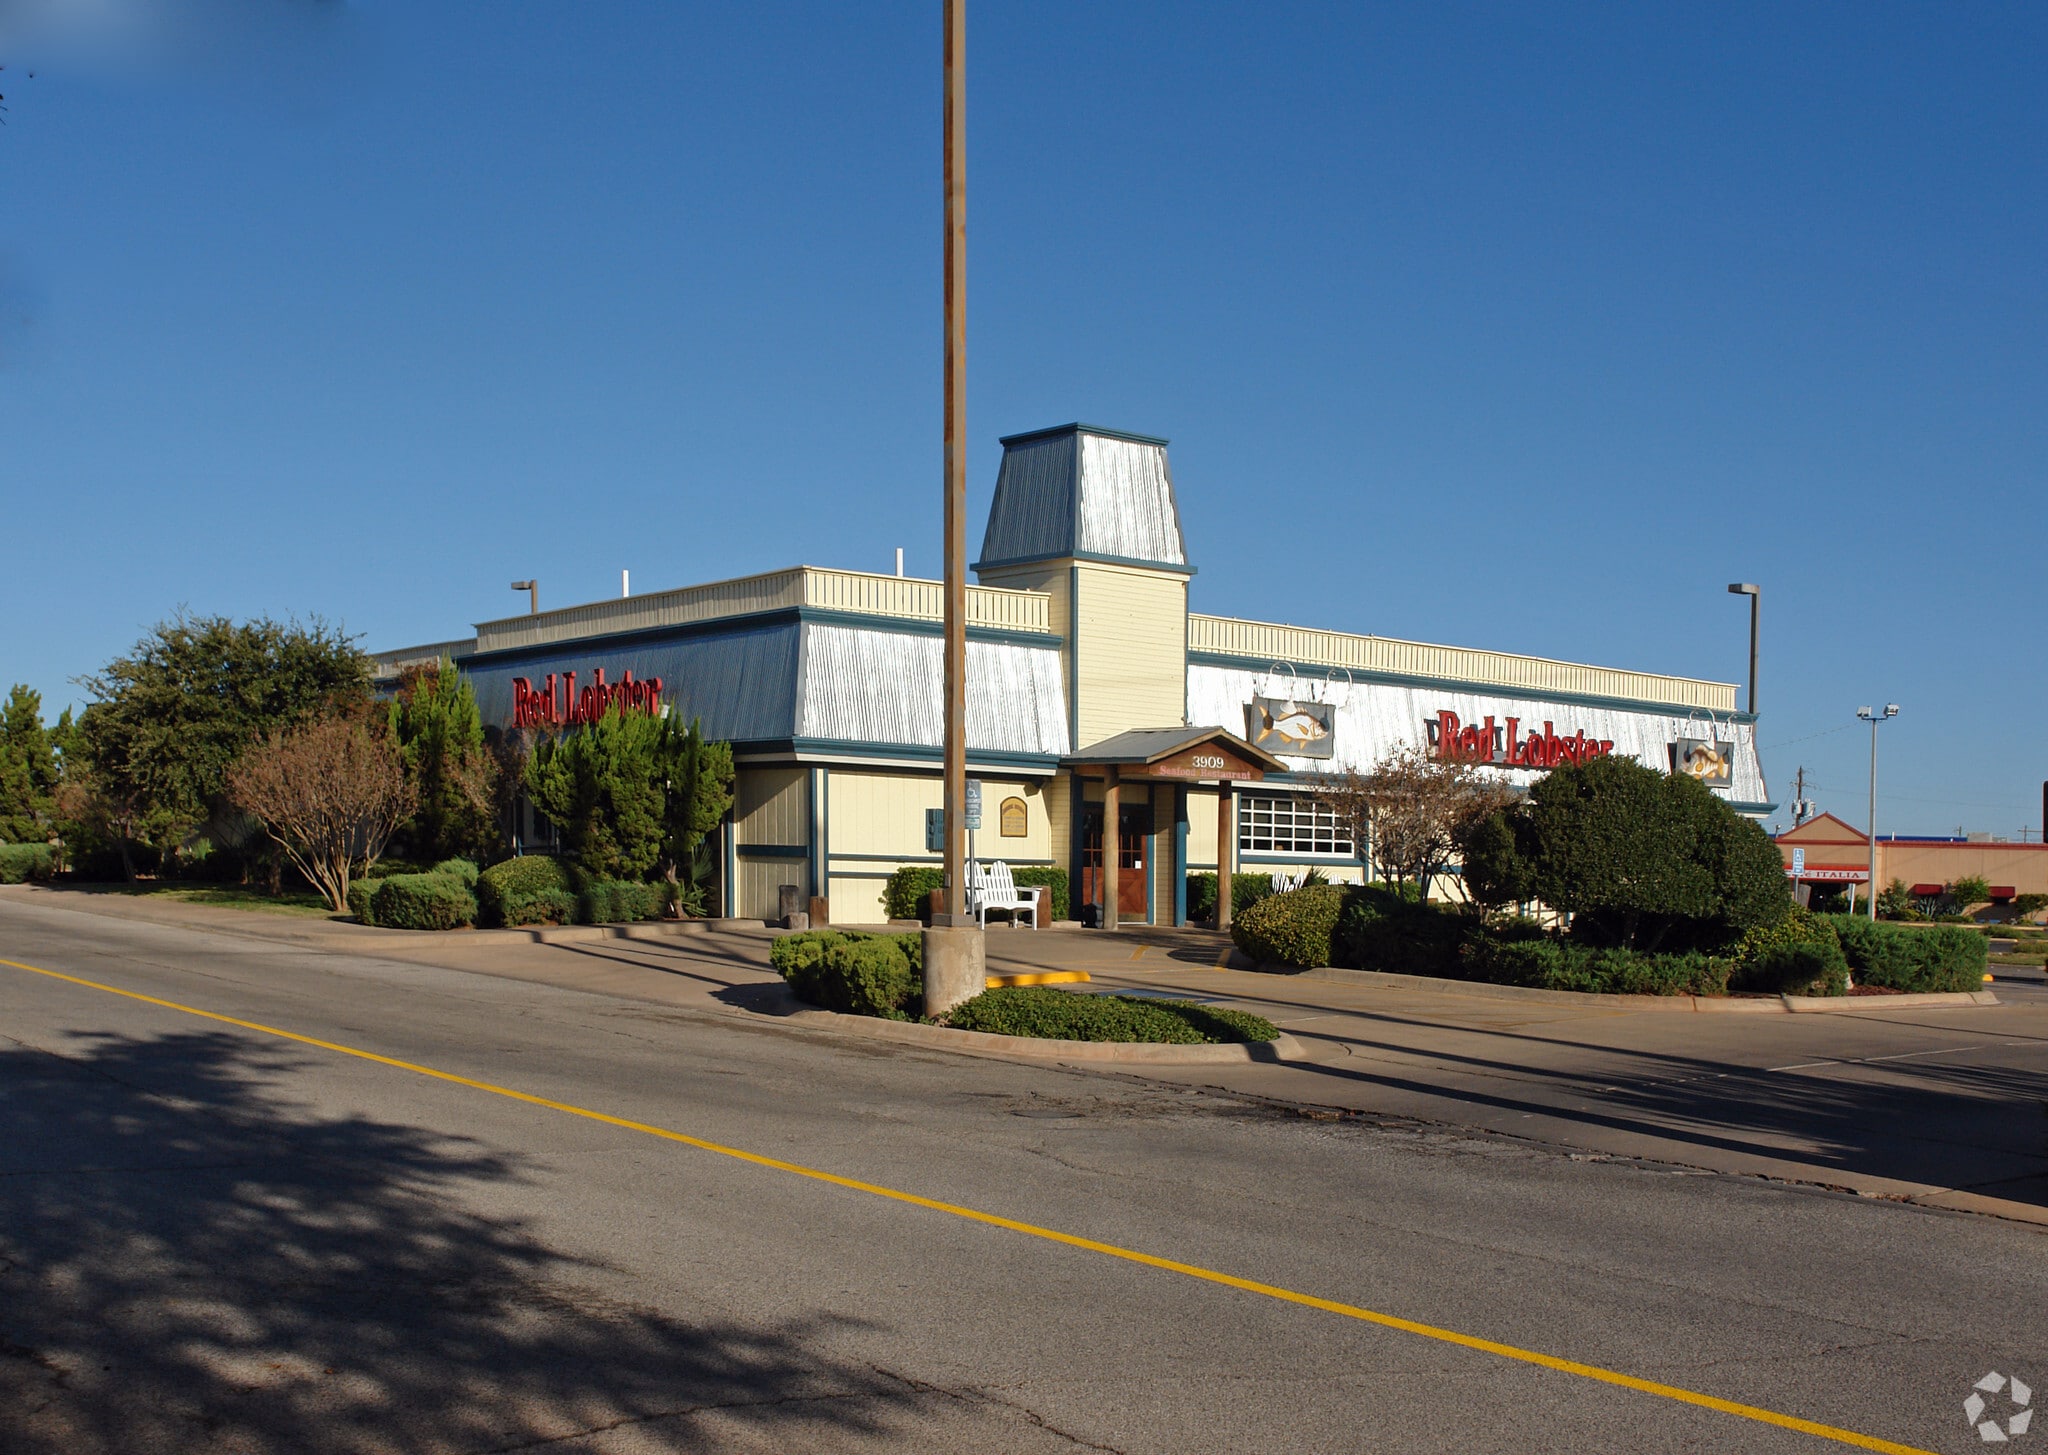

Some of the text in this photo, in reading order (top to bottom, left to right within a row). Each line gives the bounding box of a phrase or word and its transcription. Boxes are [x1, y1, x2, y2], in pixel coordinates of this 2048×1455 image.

[511, 673, 560, 728] Red
[1436, 709, 1614, 768] Red Lobster
[1160, 765, 1251, 780] Seafood Restaurant
[1192, 755, 1224, 769] 3909
